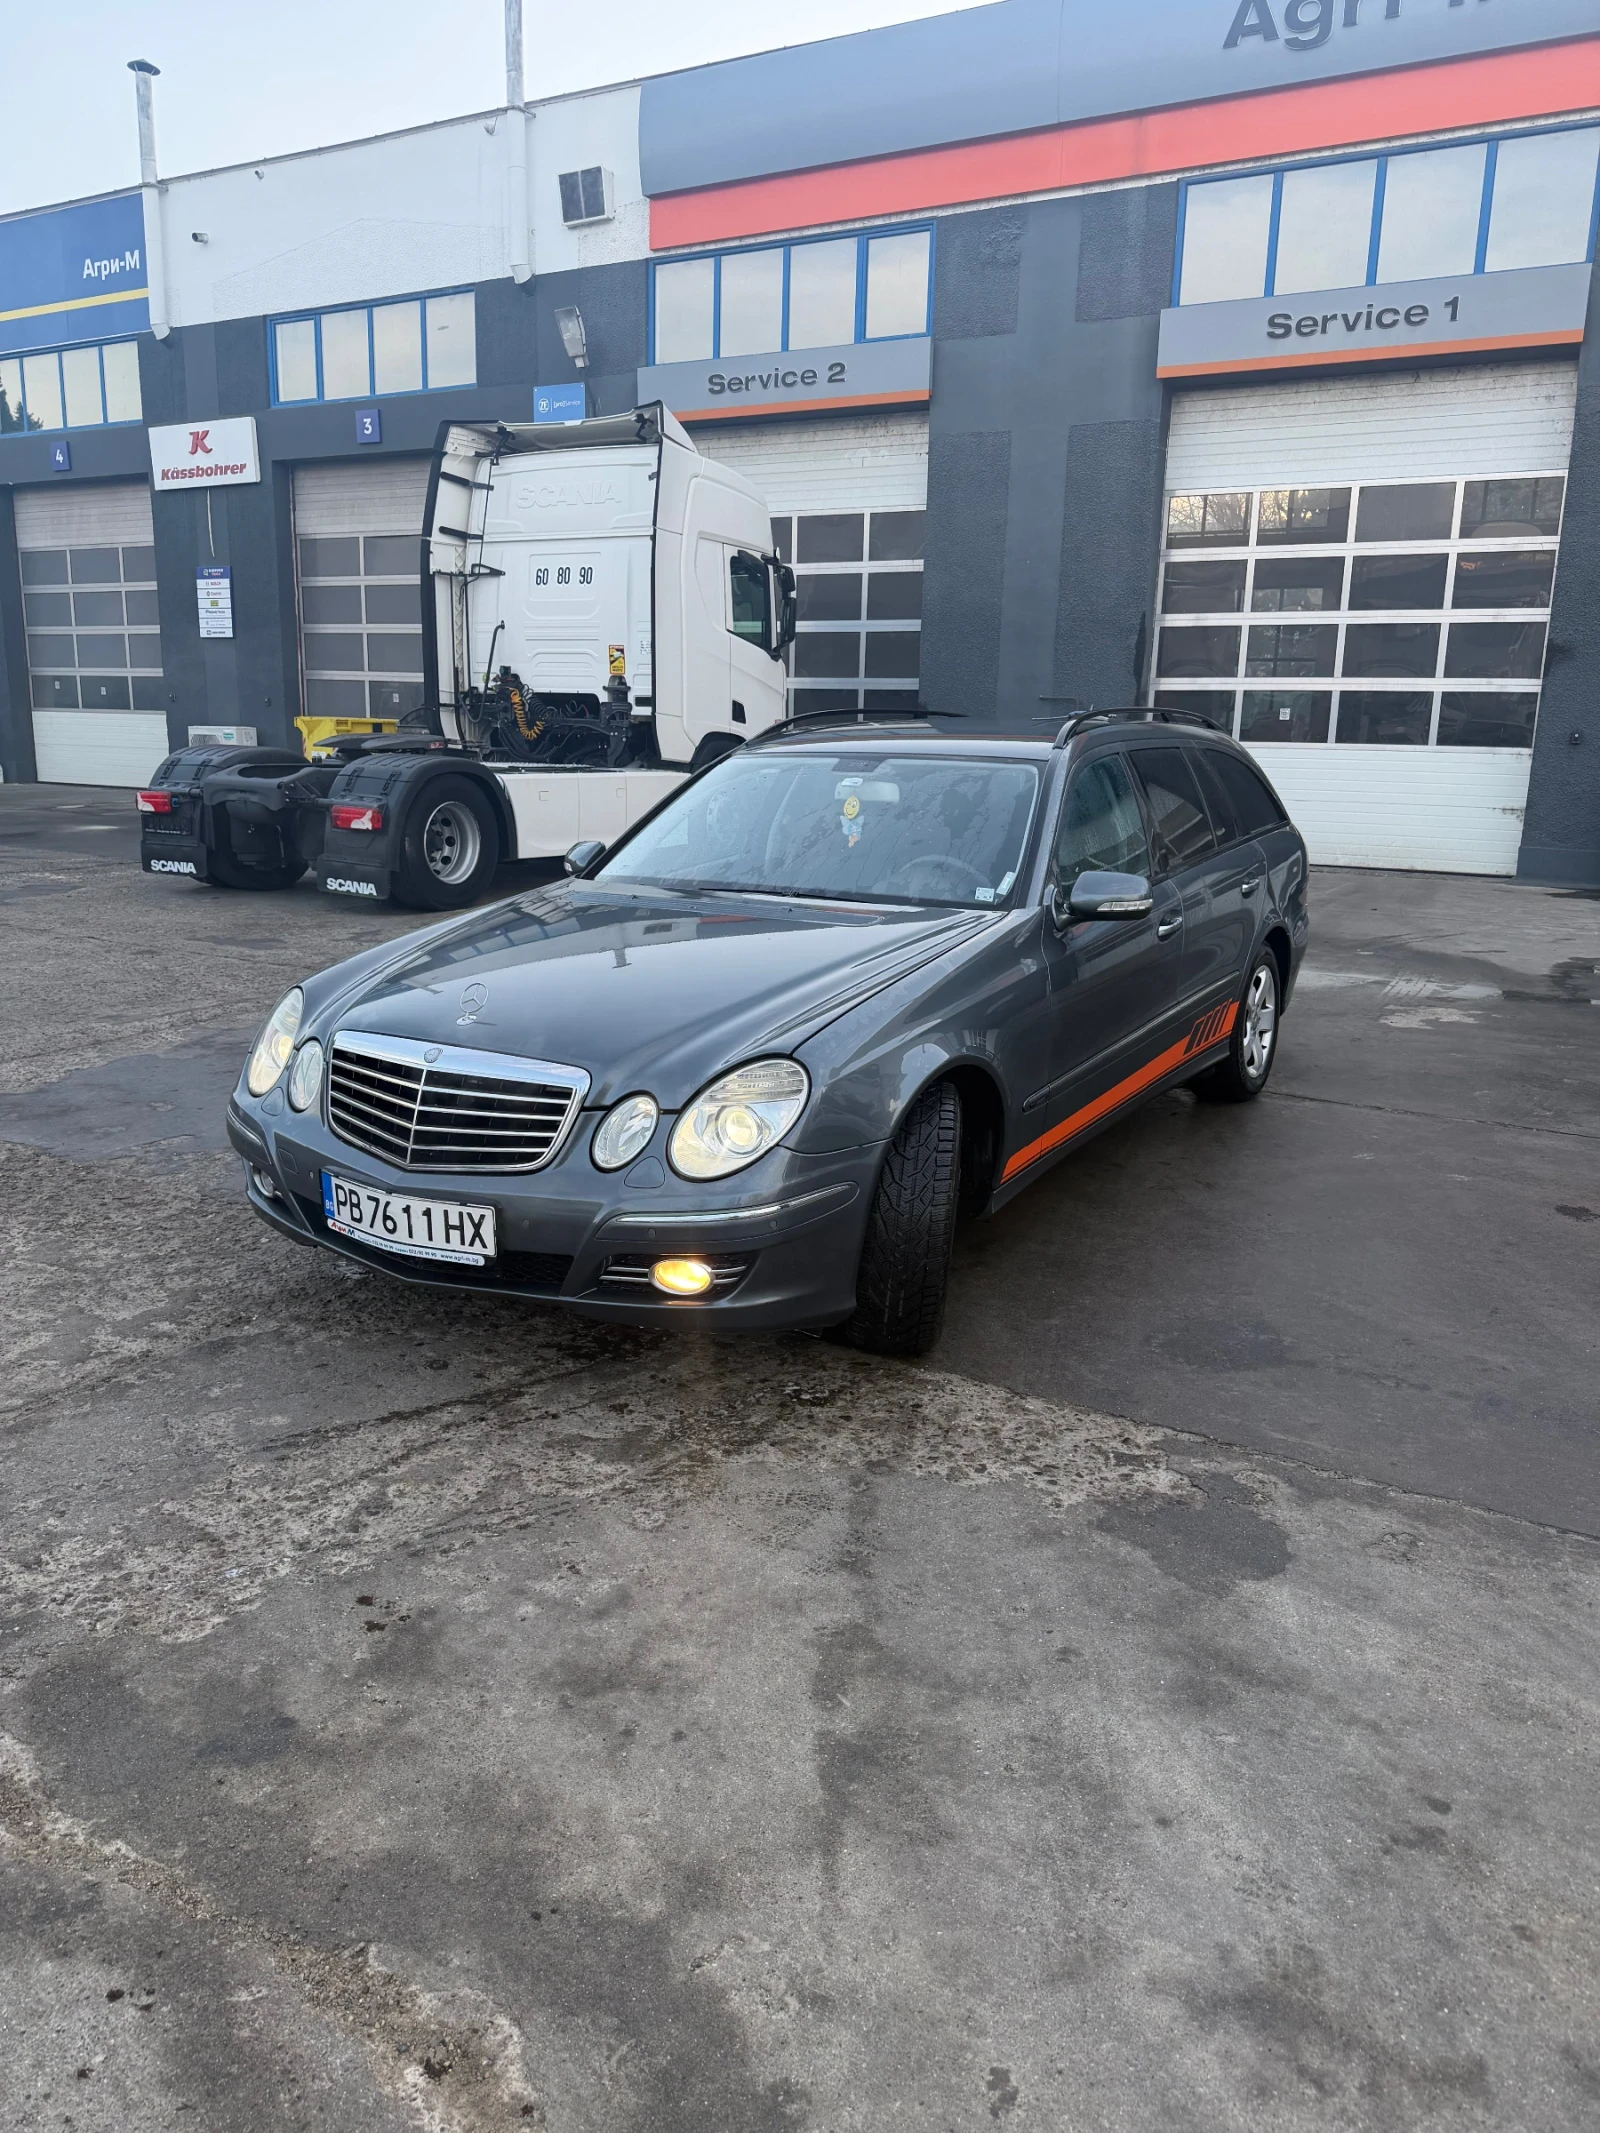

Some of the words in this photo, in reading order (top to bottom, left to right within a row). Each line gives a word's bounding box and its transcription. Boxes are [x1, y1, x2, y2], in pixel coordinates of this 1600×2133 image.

[83, 249, 140, 281] Агри-М
[1266, 303, 1430, 339] Service
[1443, 296, 1460, 322] 1
[708, 367, 818, 395] Service
[827, 362, 846, 383] 2
[363, 418, 373, 435] 3
[188, 430, 213, 455] K
[55, 449, 64, 463] 4
[161, 463, 247, 481] Kässbohrer
[515, 481, 622, 509] SCANIA
[535, 568, 549, 585] 60
[557, 566, 571, 585] 80
[579, 566, 593, 585] 90
[150, 859, 197, 874] SCANIA
[326, 877, 377, 896] SCANIA
[325, 1200, 334, 1211] BG
